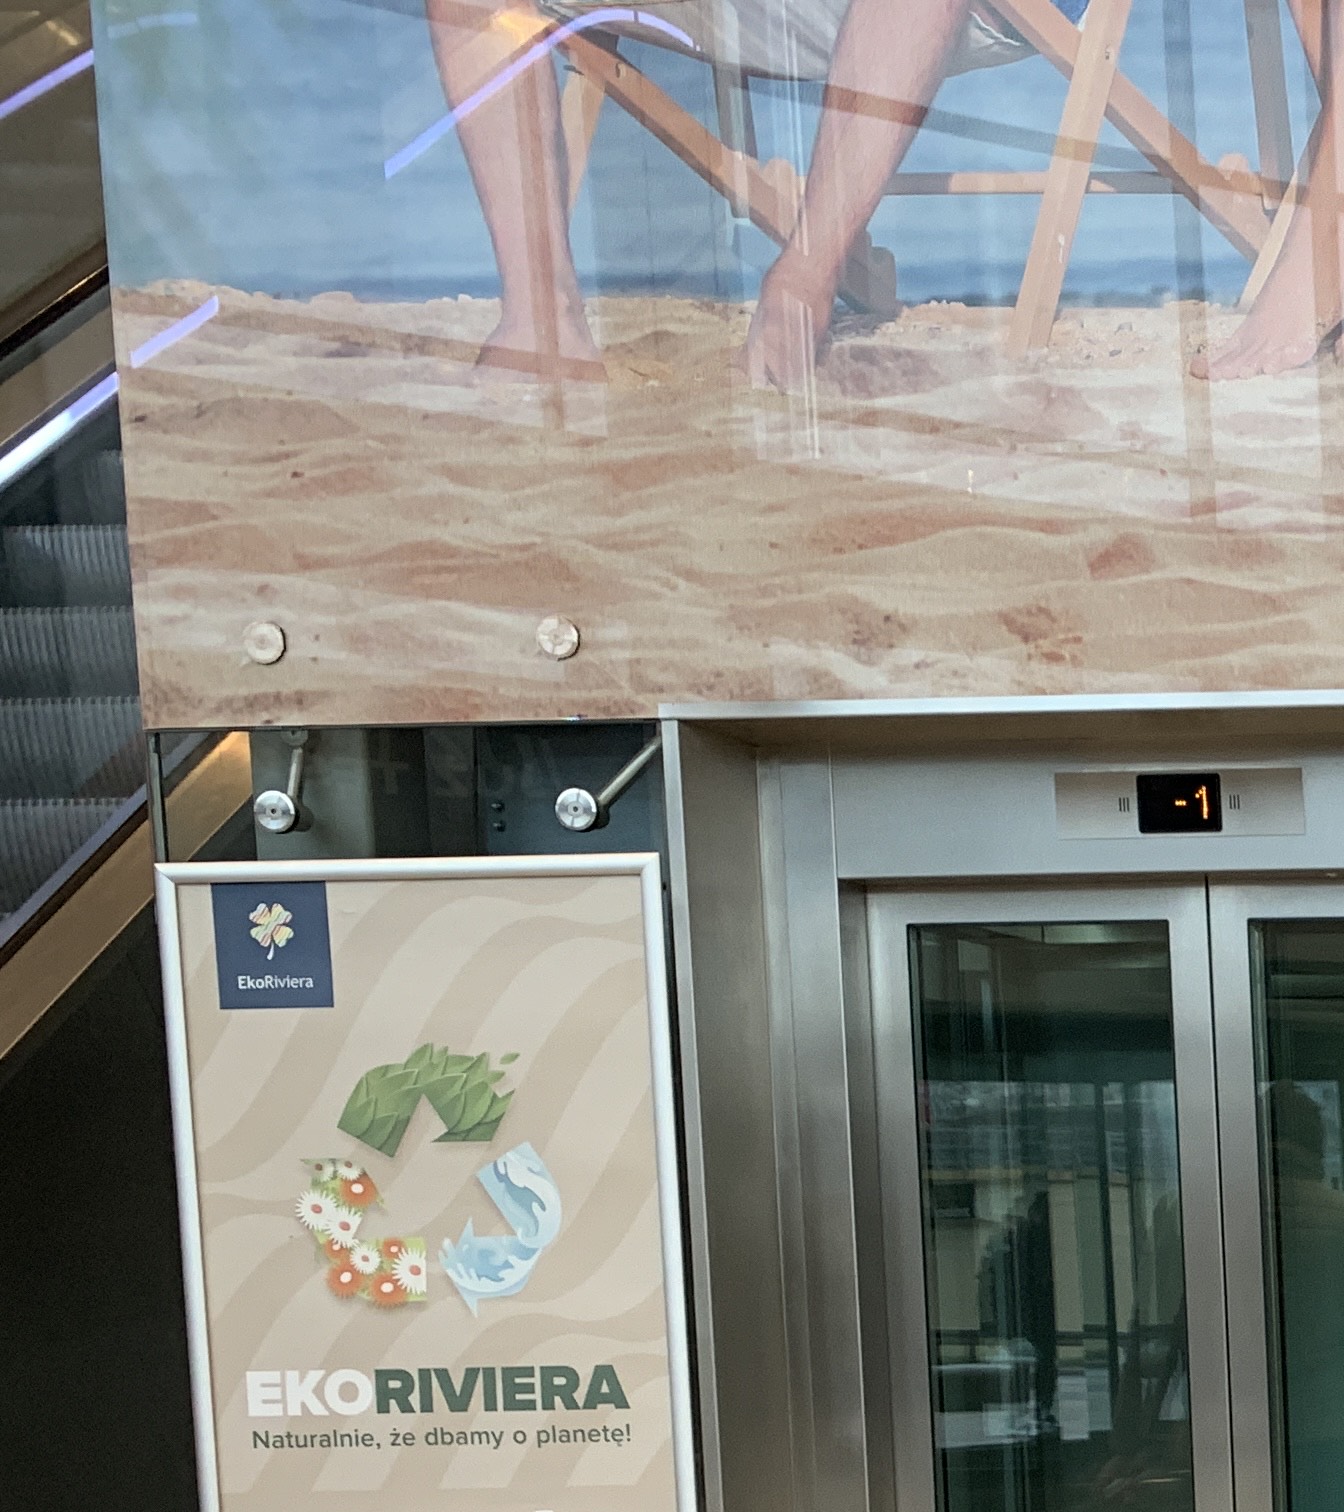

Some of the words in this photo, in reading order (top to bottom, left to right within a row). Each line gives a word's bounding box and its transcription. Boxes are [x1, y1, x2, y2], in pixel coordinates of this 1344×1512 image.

[1174, 785, 1209, 820] -1
[237, 975, 314, 989] EkoRiviera
[245, 1364, 631, 1417] EKORIVIERA
[252, 1429, 381, 1450] Naturalnie,
[389, 1427, 416, 1447] że
[424, 1426, 504, 1450] dbamy
[512, 1429, 527, 1445] o
[537, 1424, 632, 1450] planetę!
